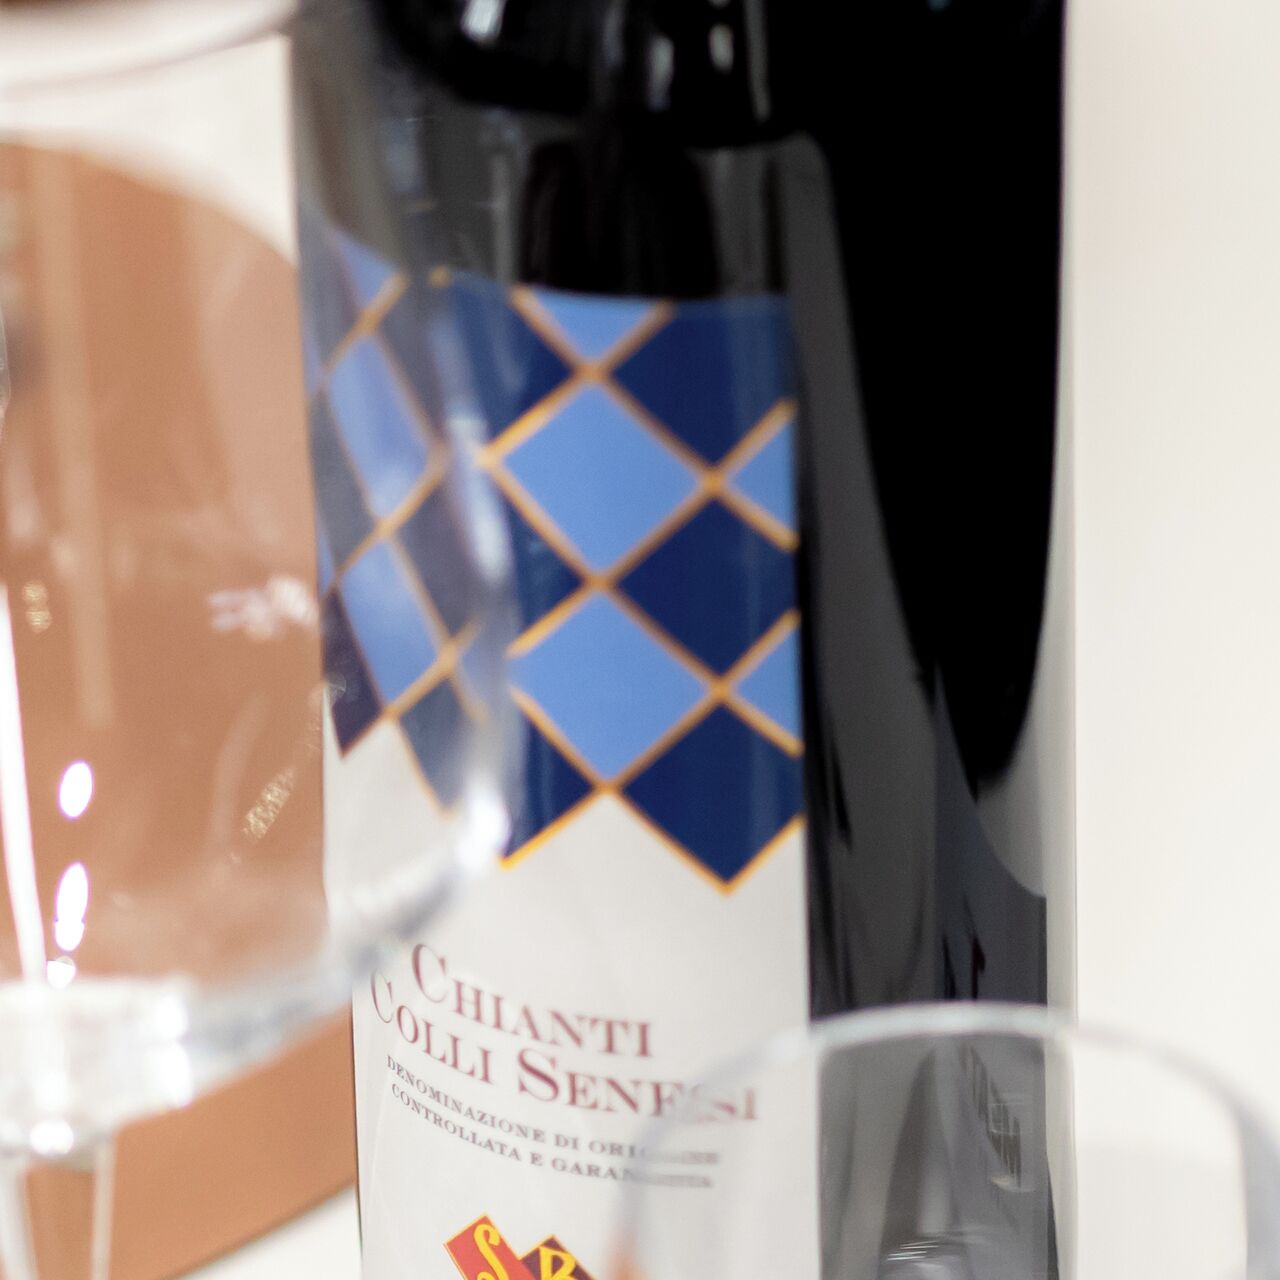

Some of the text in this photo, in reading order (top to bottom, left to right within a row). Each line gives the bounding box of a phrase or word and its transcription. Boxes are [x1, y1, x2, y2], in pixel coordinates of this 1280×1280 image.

[370, 969, 493, 1085] COLLI
[411, 943, 653, 1058] CHIANTI
[386, 1055, 546, 1143] DENOMINAZIONE
[554, 1133, 580, 1149] DI
[391, 1083, 521, 1161] CONTROLLATA
[529, 1151, 544, 1167] E
